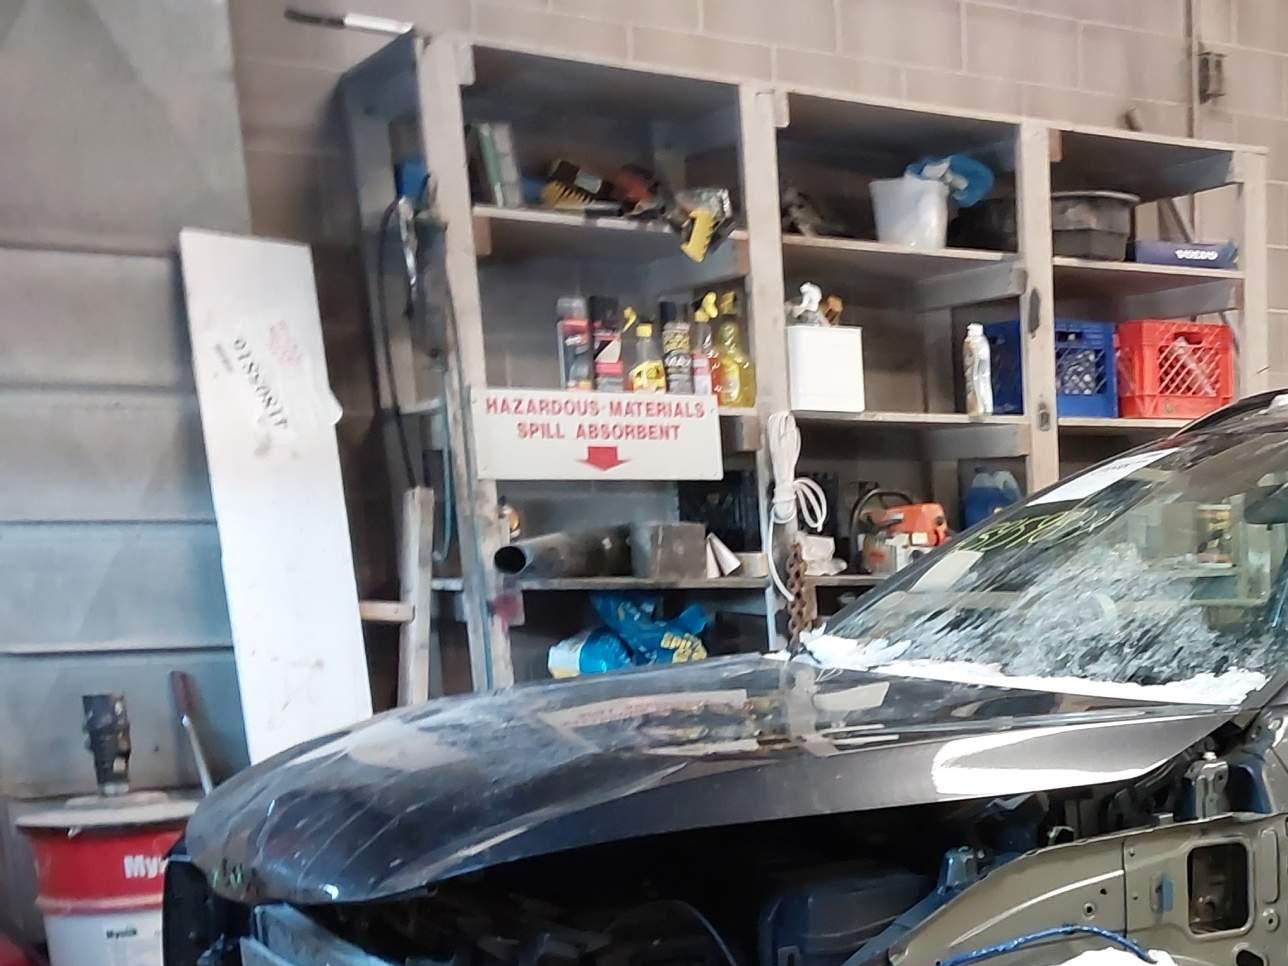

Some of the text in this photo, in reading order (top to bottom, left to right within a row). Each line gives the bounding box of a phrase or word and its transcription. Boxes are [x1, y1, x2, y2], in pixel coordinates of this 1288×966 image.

[485, 397, 705, 418] HAZARDOUS MATERIALS
[517, 421, 681, 440] SPILL ABSORBENT
